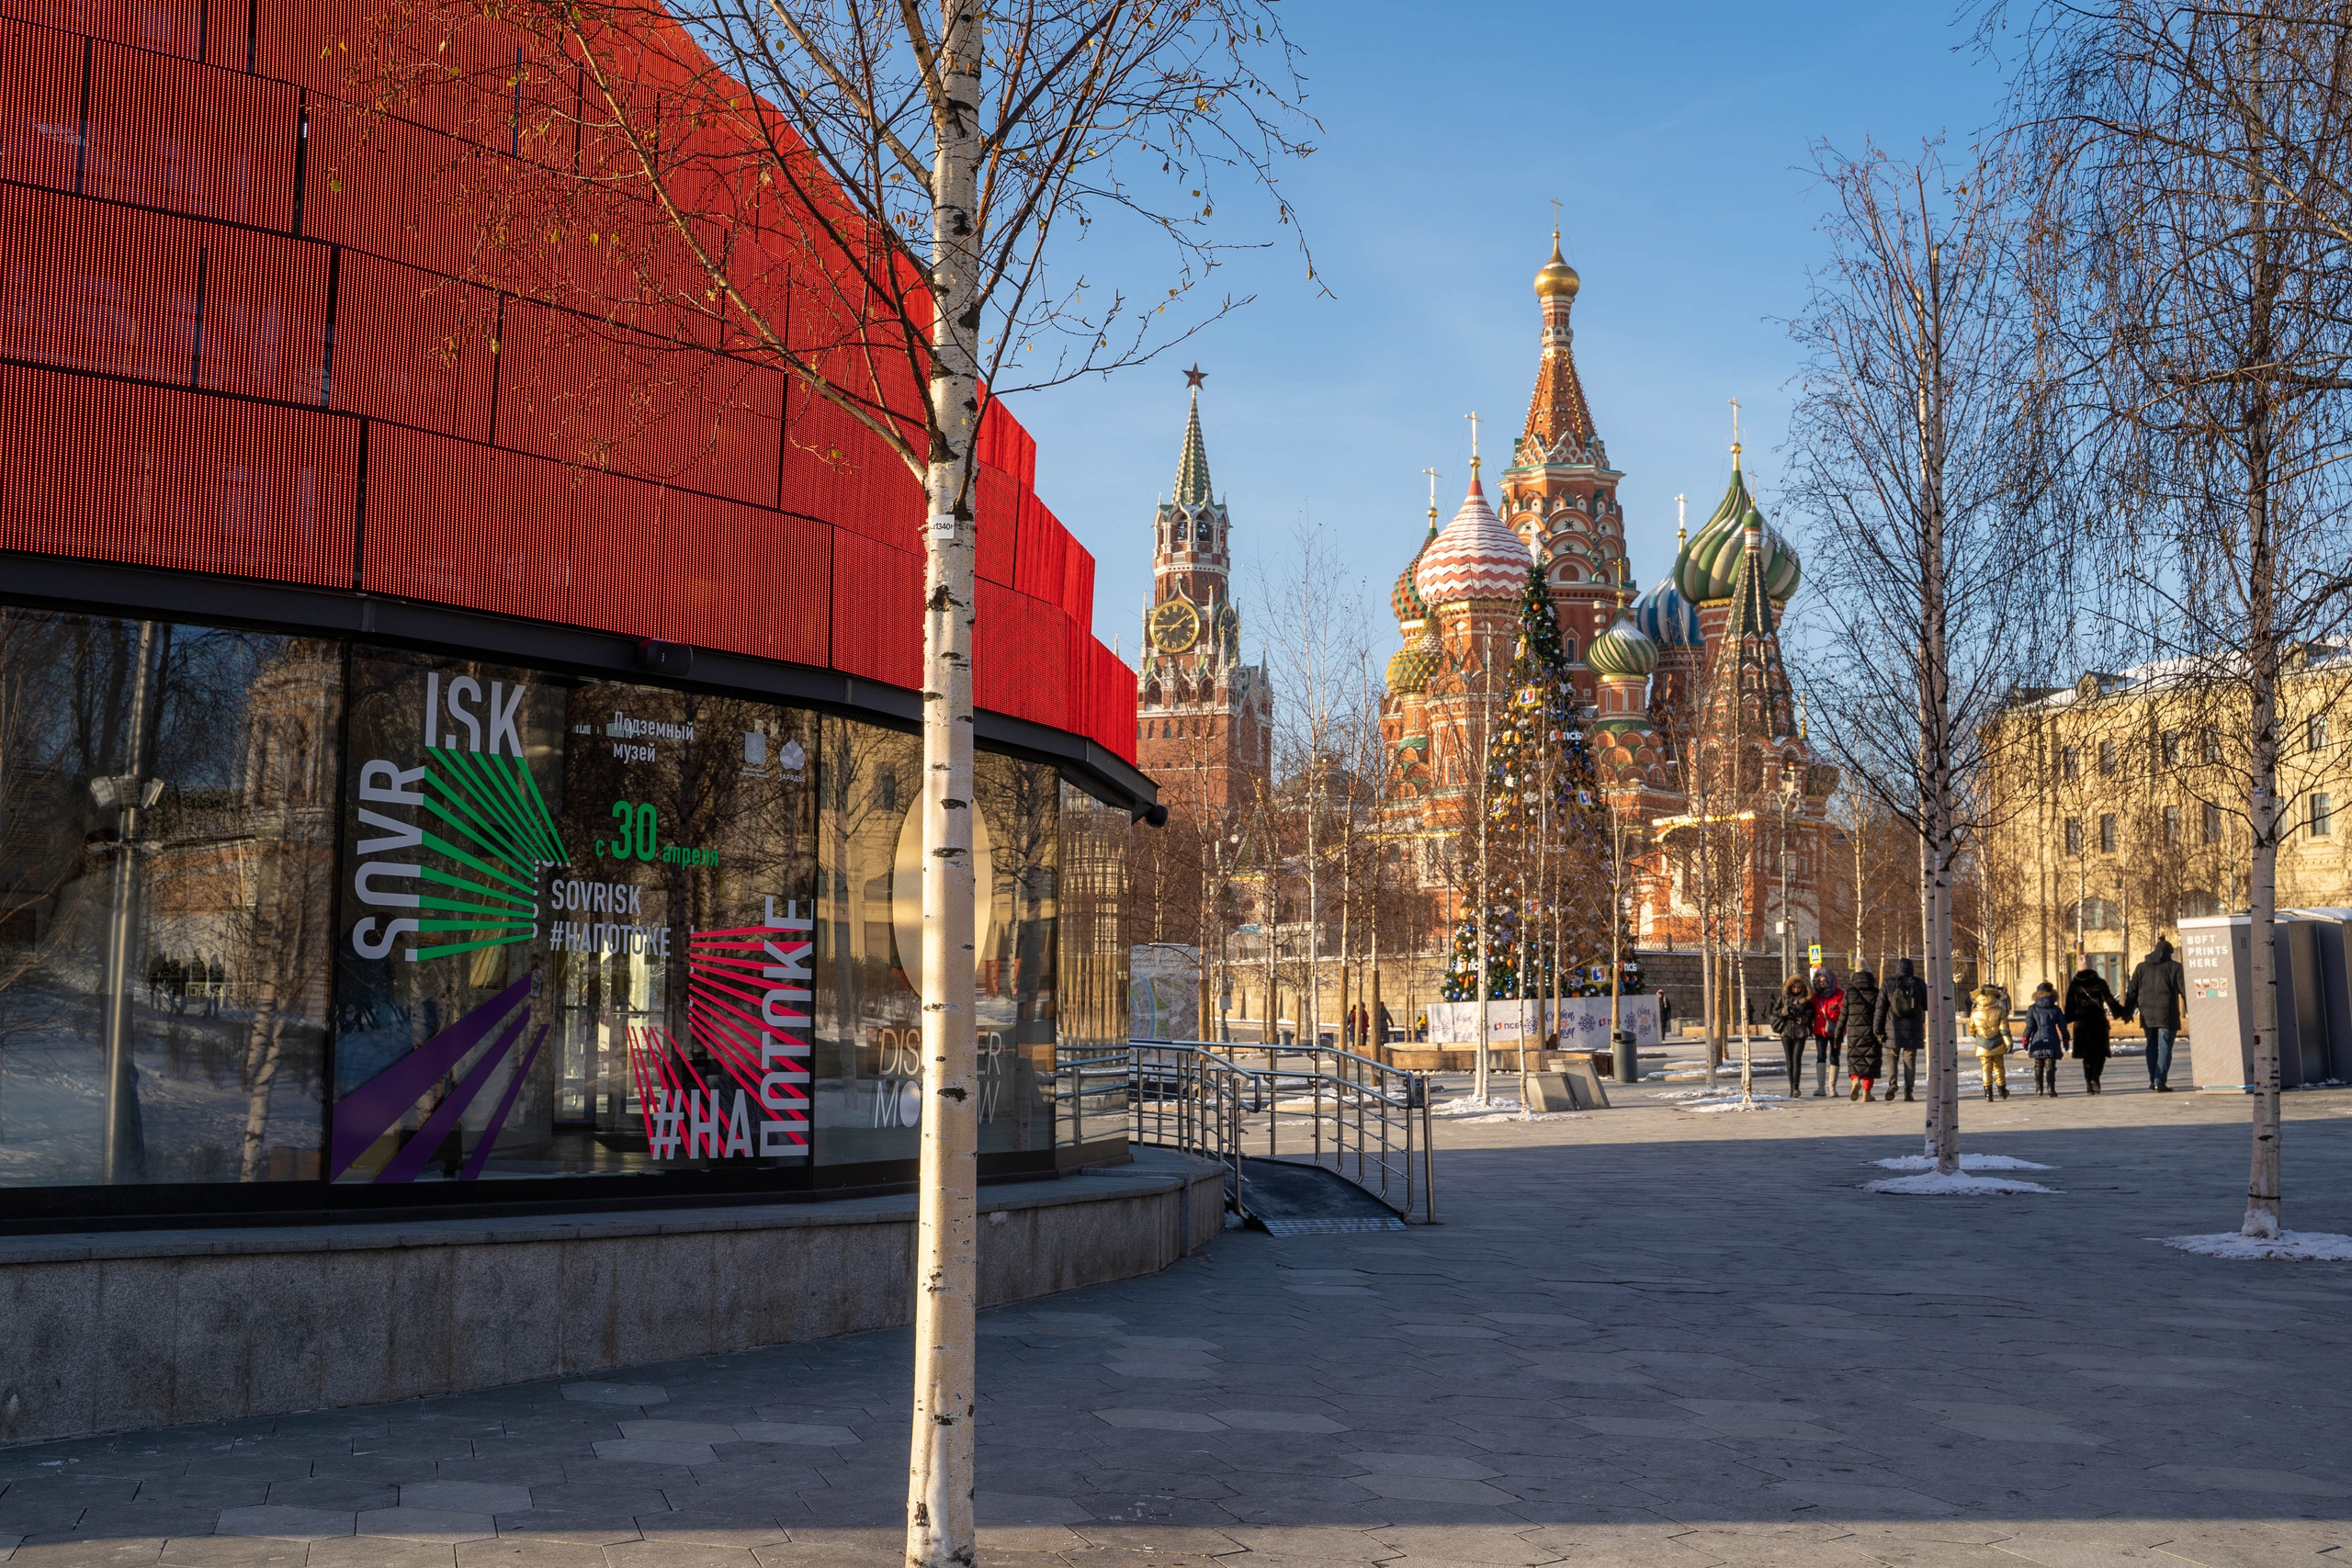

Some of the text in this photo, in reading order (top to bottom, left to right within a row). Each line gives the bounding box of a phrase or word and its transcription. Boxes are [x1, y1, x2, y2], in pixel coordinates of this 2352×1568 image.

[615, 711, 694, 740] Подземный
[613, 742, 656, 764] музей
[778, 773, 807, 784] ЗАРЯДЬЕ
[595, 800, 718, 870] с 30 апреля
[551, 878, 641, 915] SOVRISK
[549, 920, 672, 956] #НАПОТОКЕ
[2187, 934, 2215, 945] BOFT
[2188, 945, 2228, 956] PRINTS
[2188, 958, 2218, 968] HERE
[879, 1028, 1001, 1076] DISER
[650, 1089, 753, 1160] #НА
